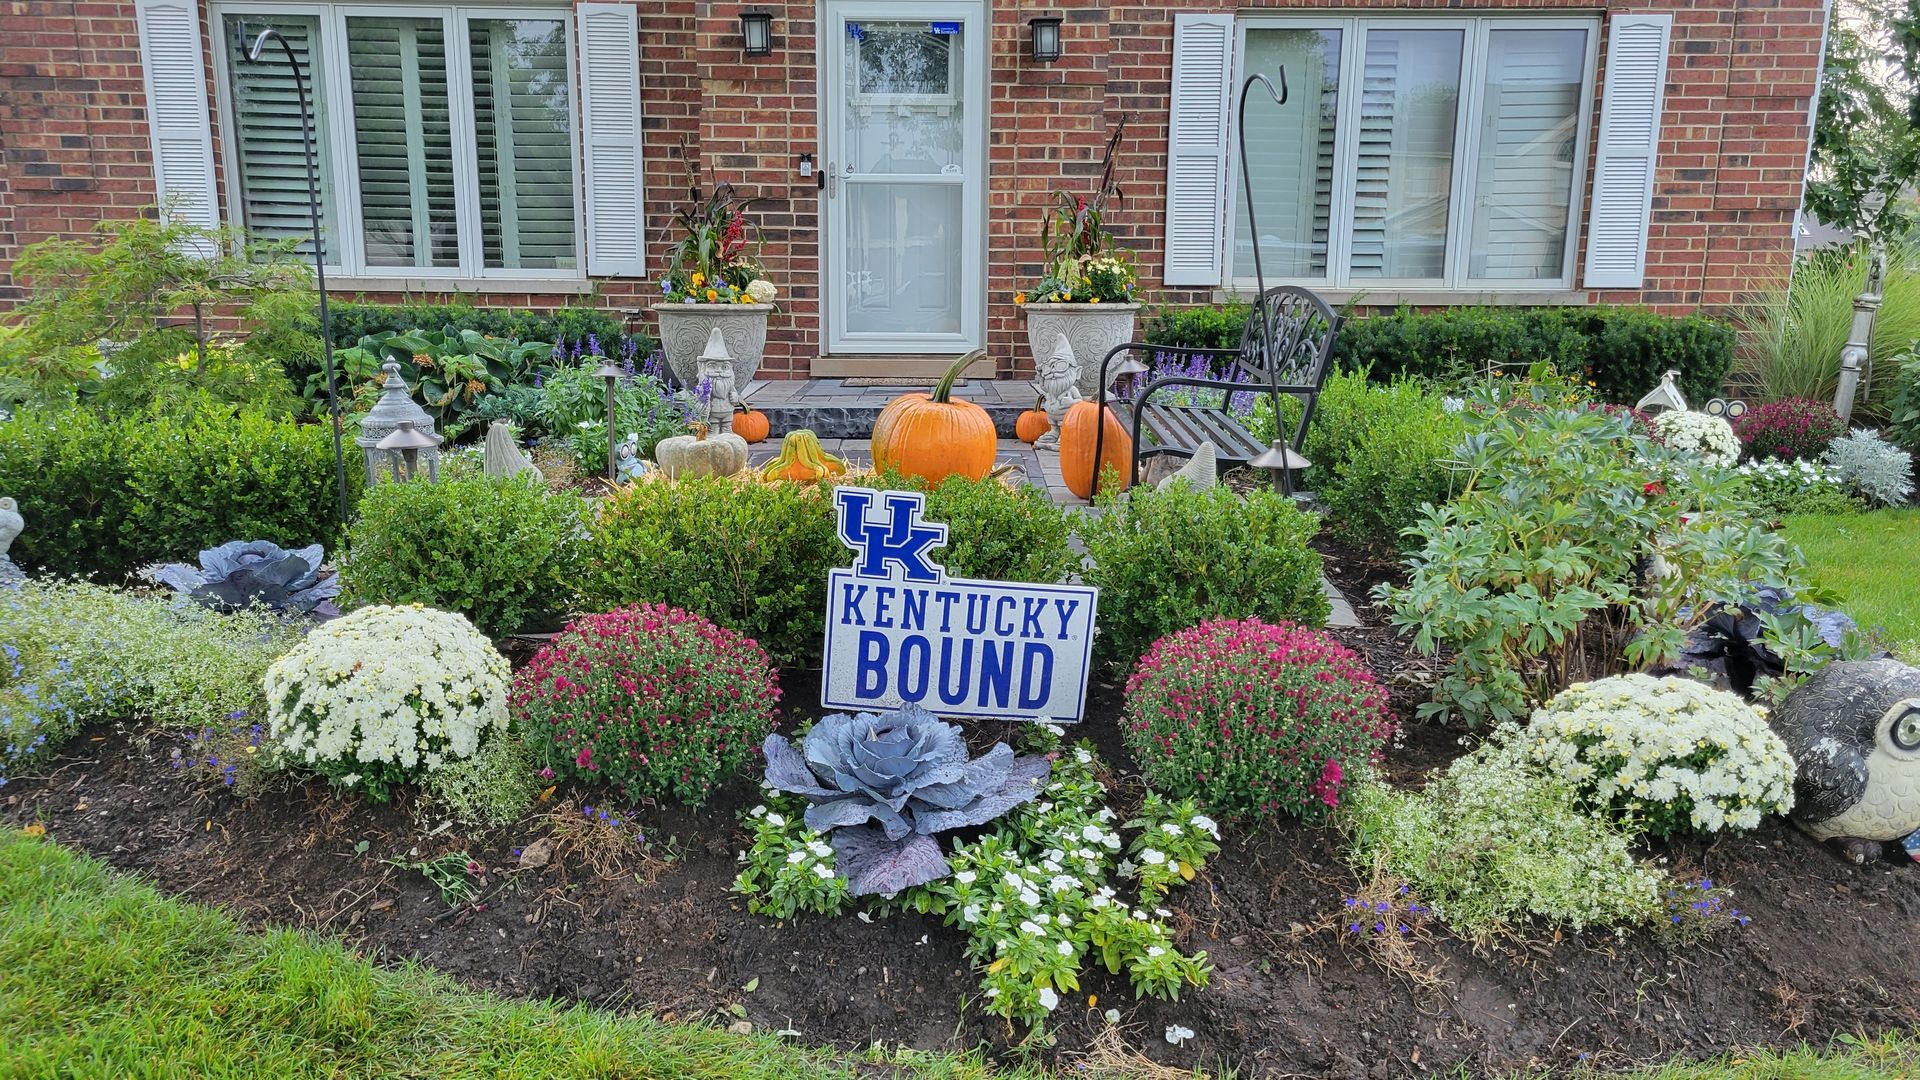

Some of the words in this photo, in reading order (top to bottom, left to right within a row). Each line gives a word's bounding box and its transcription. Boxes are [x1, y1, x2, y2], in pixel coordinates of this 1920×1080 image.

[846, 23, 864, 39] UK
[837, 490, 945, 584] UK
[841, 584, 1079, 640] KENTUCKY
[855, 630, 1054, 710] BOUND
